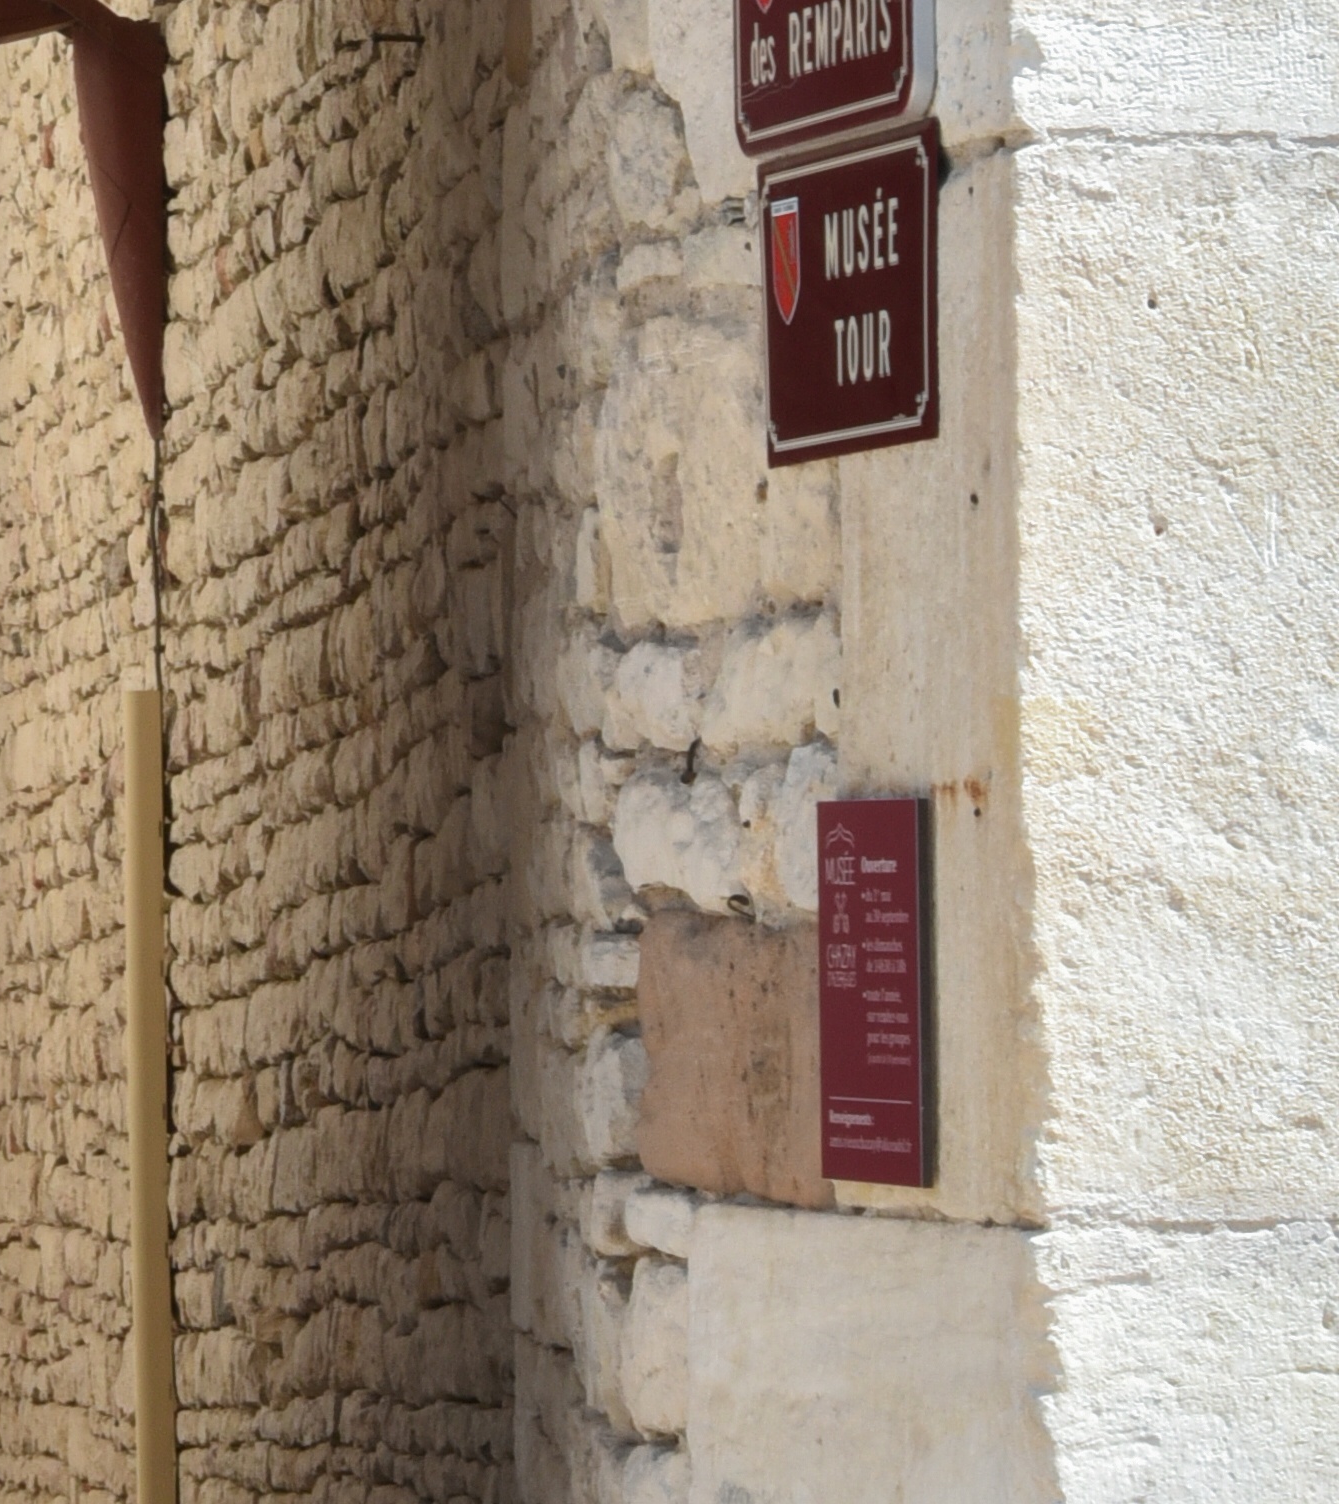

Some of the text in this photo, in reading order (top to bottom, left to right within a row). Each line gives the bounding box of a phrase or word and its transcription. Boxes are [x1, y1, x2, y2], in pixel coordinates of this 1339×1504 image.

[750, 22, 776, 87] des
[825, 187, 899, 281] MUSÉE
[834, 309, 891, 386] TOUR
